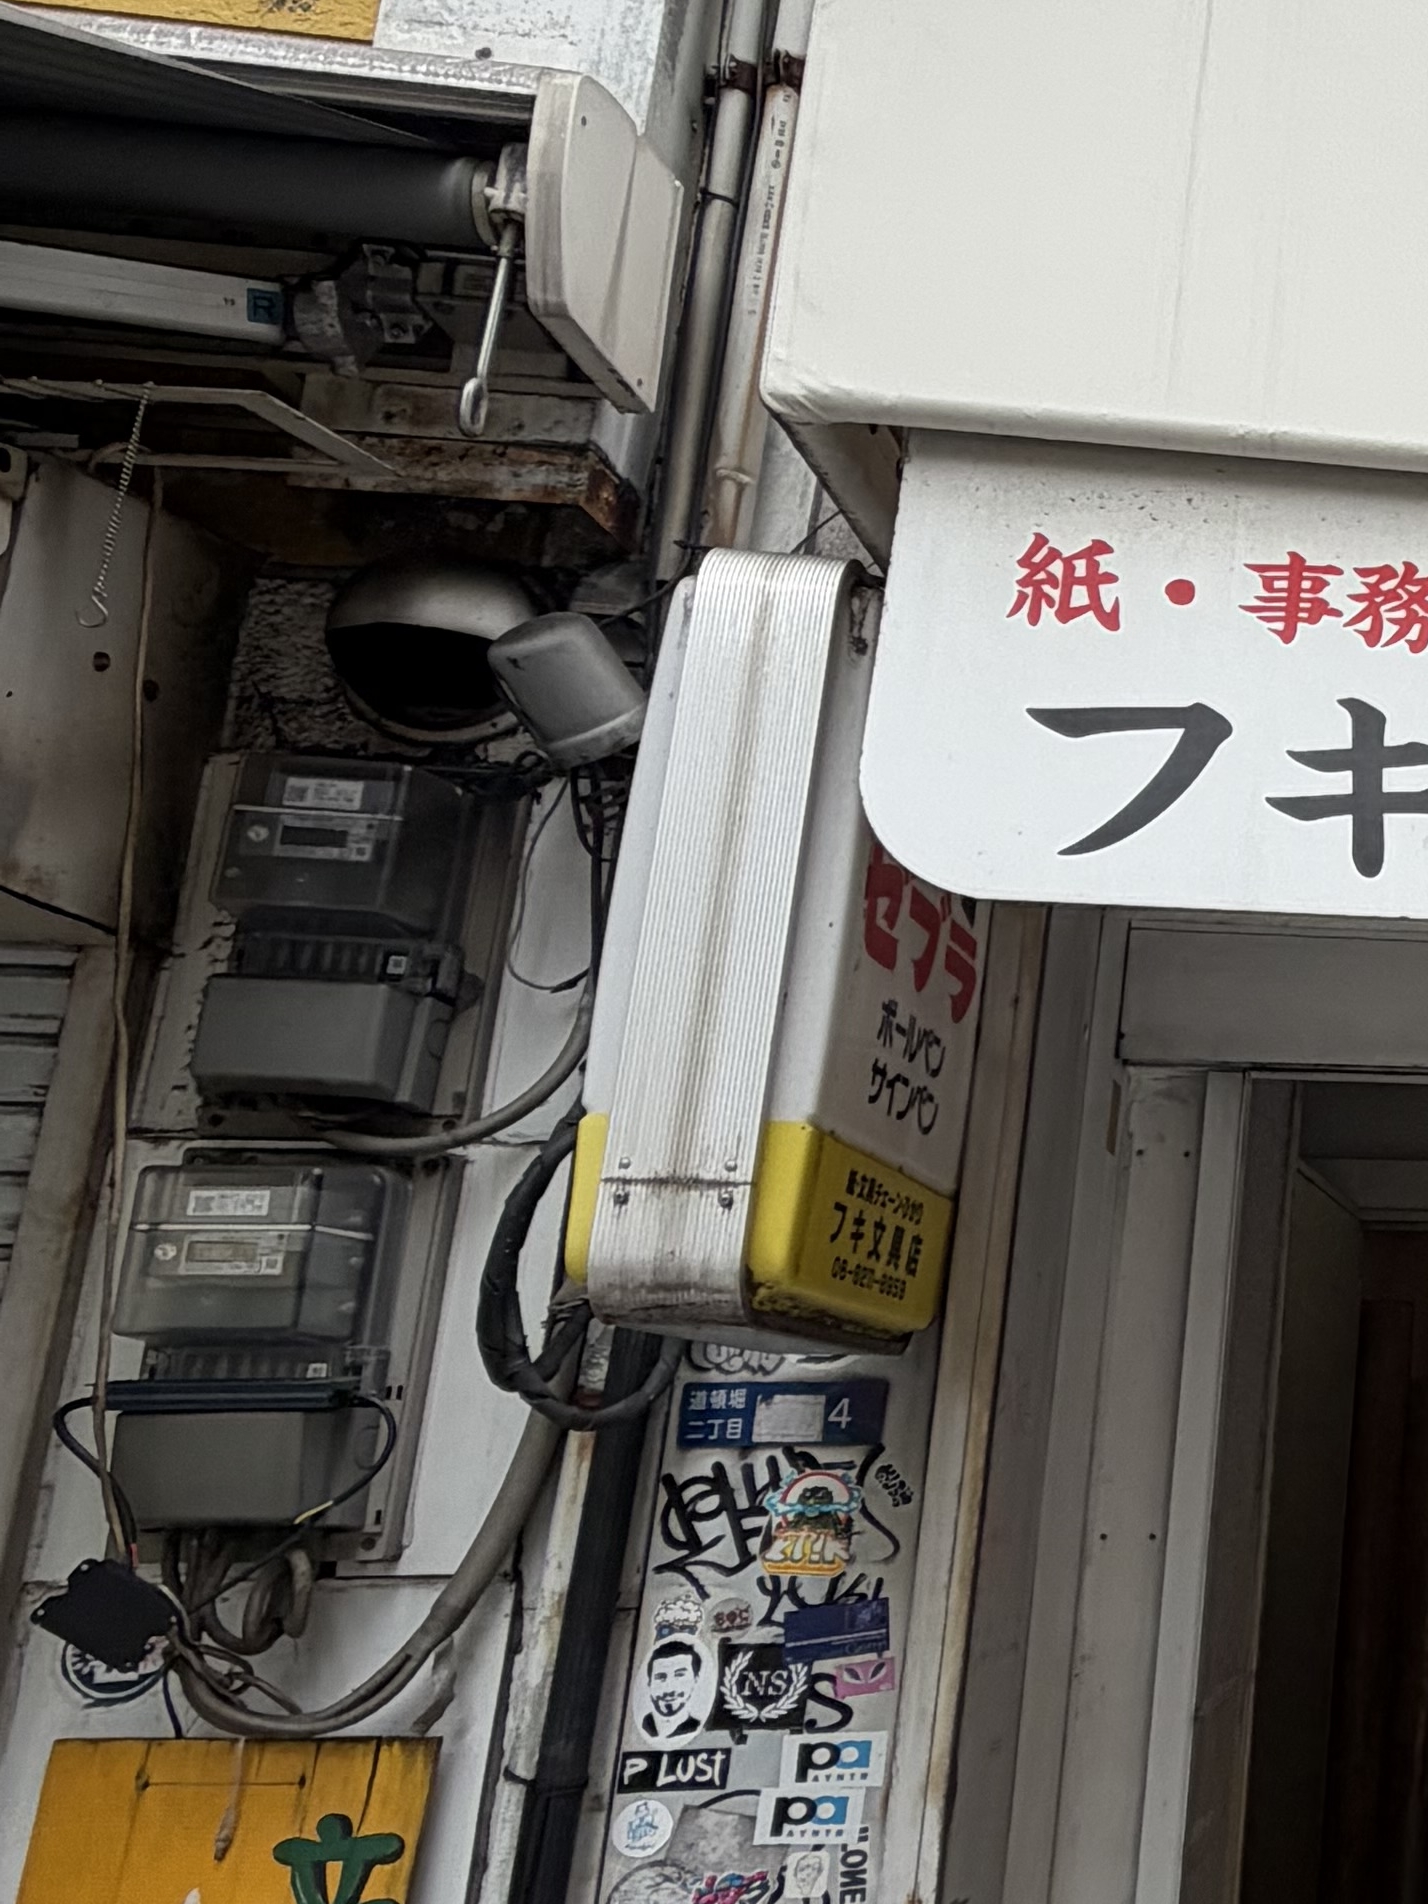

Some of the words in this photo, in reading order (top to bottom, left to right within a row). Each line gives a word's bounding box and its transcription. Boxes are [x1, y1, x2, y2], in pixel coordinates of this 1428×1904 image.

[876, 999, 947, 1080] ボールペン
[867, 1057, 938, 1136] サインペン
[683, 1417, 744, 1441] 二丁目
[826, 1396, 853, 1430] 4
[687, 1387, 748, 1412] 道頓堀
